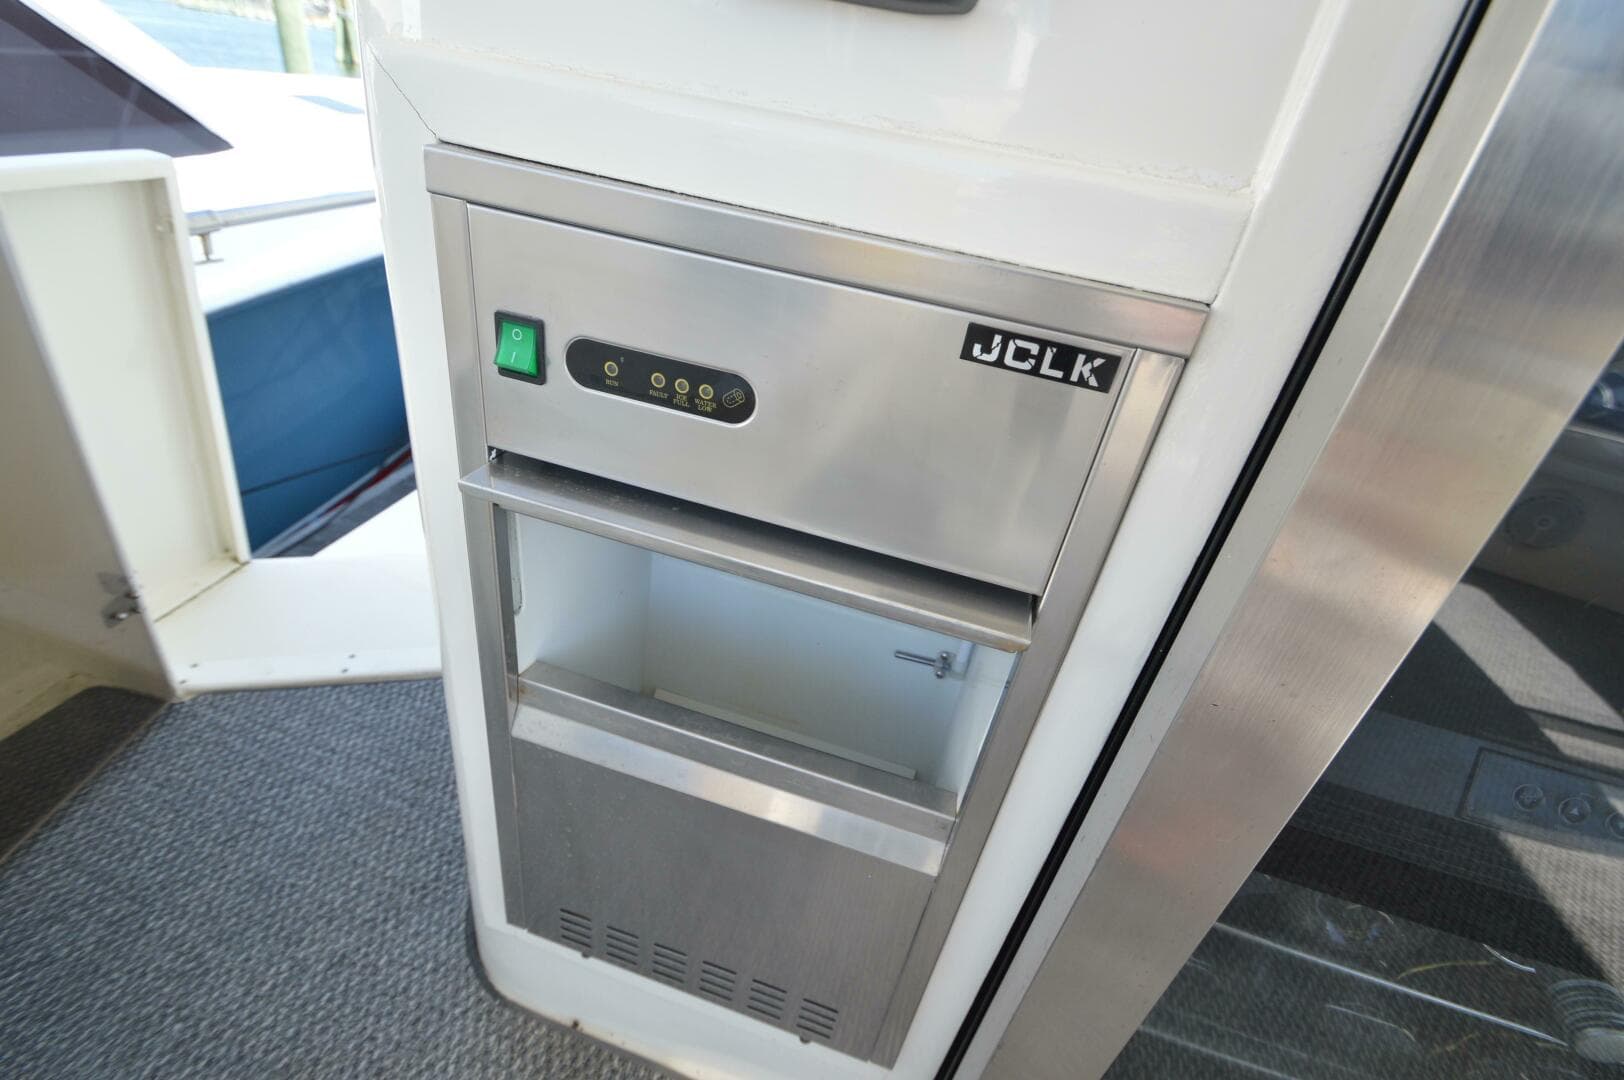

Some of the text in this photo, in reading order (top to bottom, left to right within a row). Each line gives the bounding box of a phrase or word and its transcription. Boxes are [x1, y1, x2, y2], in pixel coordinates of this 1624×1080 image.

[973, 334, 1106, 387] JCLK
[605, 378, 620, 387] RUN
[649, 389, 669, 399] FAULT
[674, 394, 688, 402] ICE
[673, 399, 690, 408] FULL
[694, 398, 717, 408] WATER
[697, 405, 712, 413] LOW
